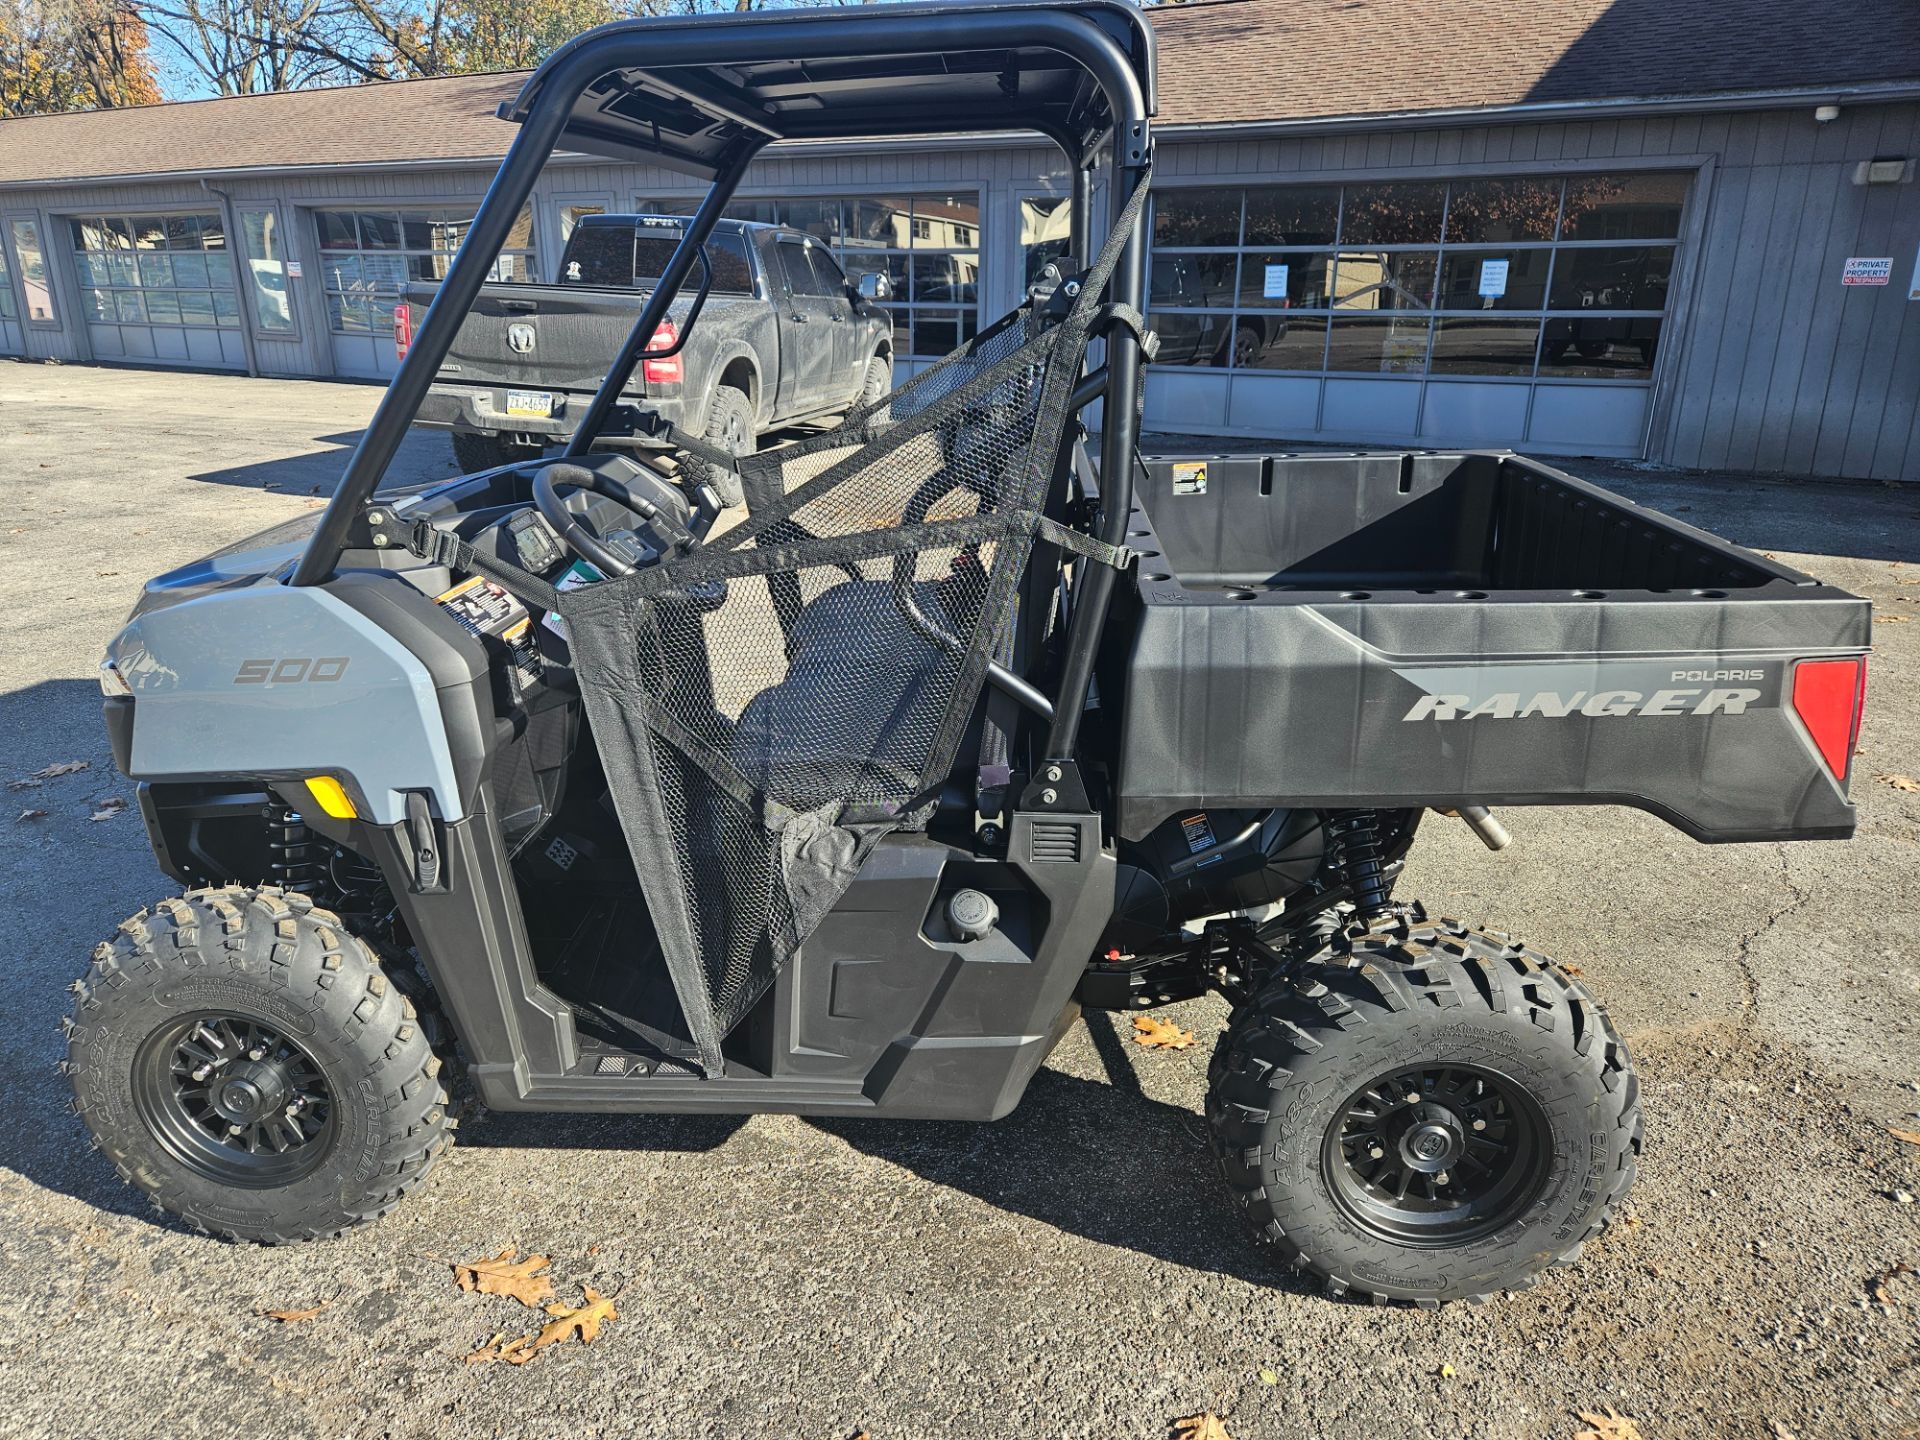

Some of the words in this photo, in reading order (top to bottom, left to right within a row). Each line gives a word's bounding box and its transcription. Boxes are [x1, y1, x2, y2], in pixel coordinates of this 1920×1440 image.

[1846, 269, 1888, 277] PROPERTY
[1857, 261, 1889, 269] PRIVATE
[233, 656, 350, 685] 500
[1671, 669, 1765, 683] POLARIS
[1402, 688, 1762, 722] RANGER
[355, 1079, 381, 1183] CARLSTAR
[1274, 1081, 1315, 1187] AT489
[1550, 1130, 1608, 1240] CARLSTAR
